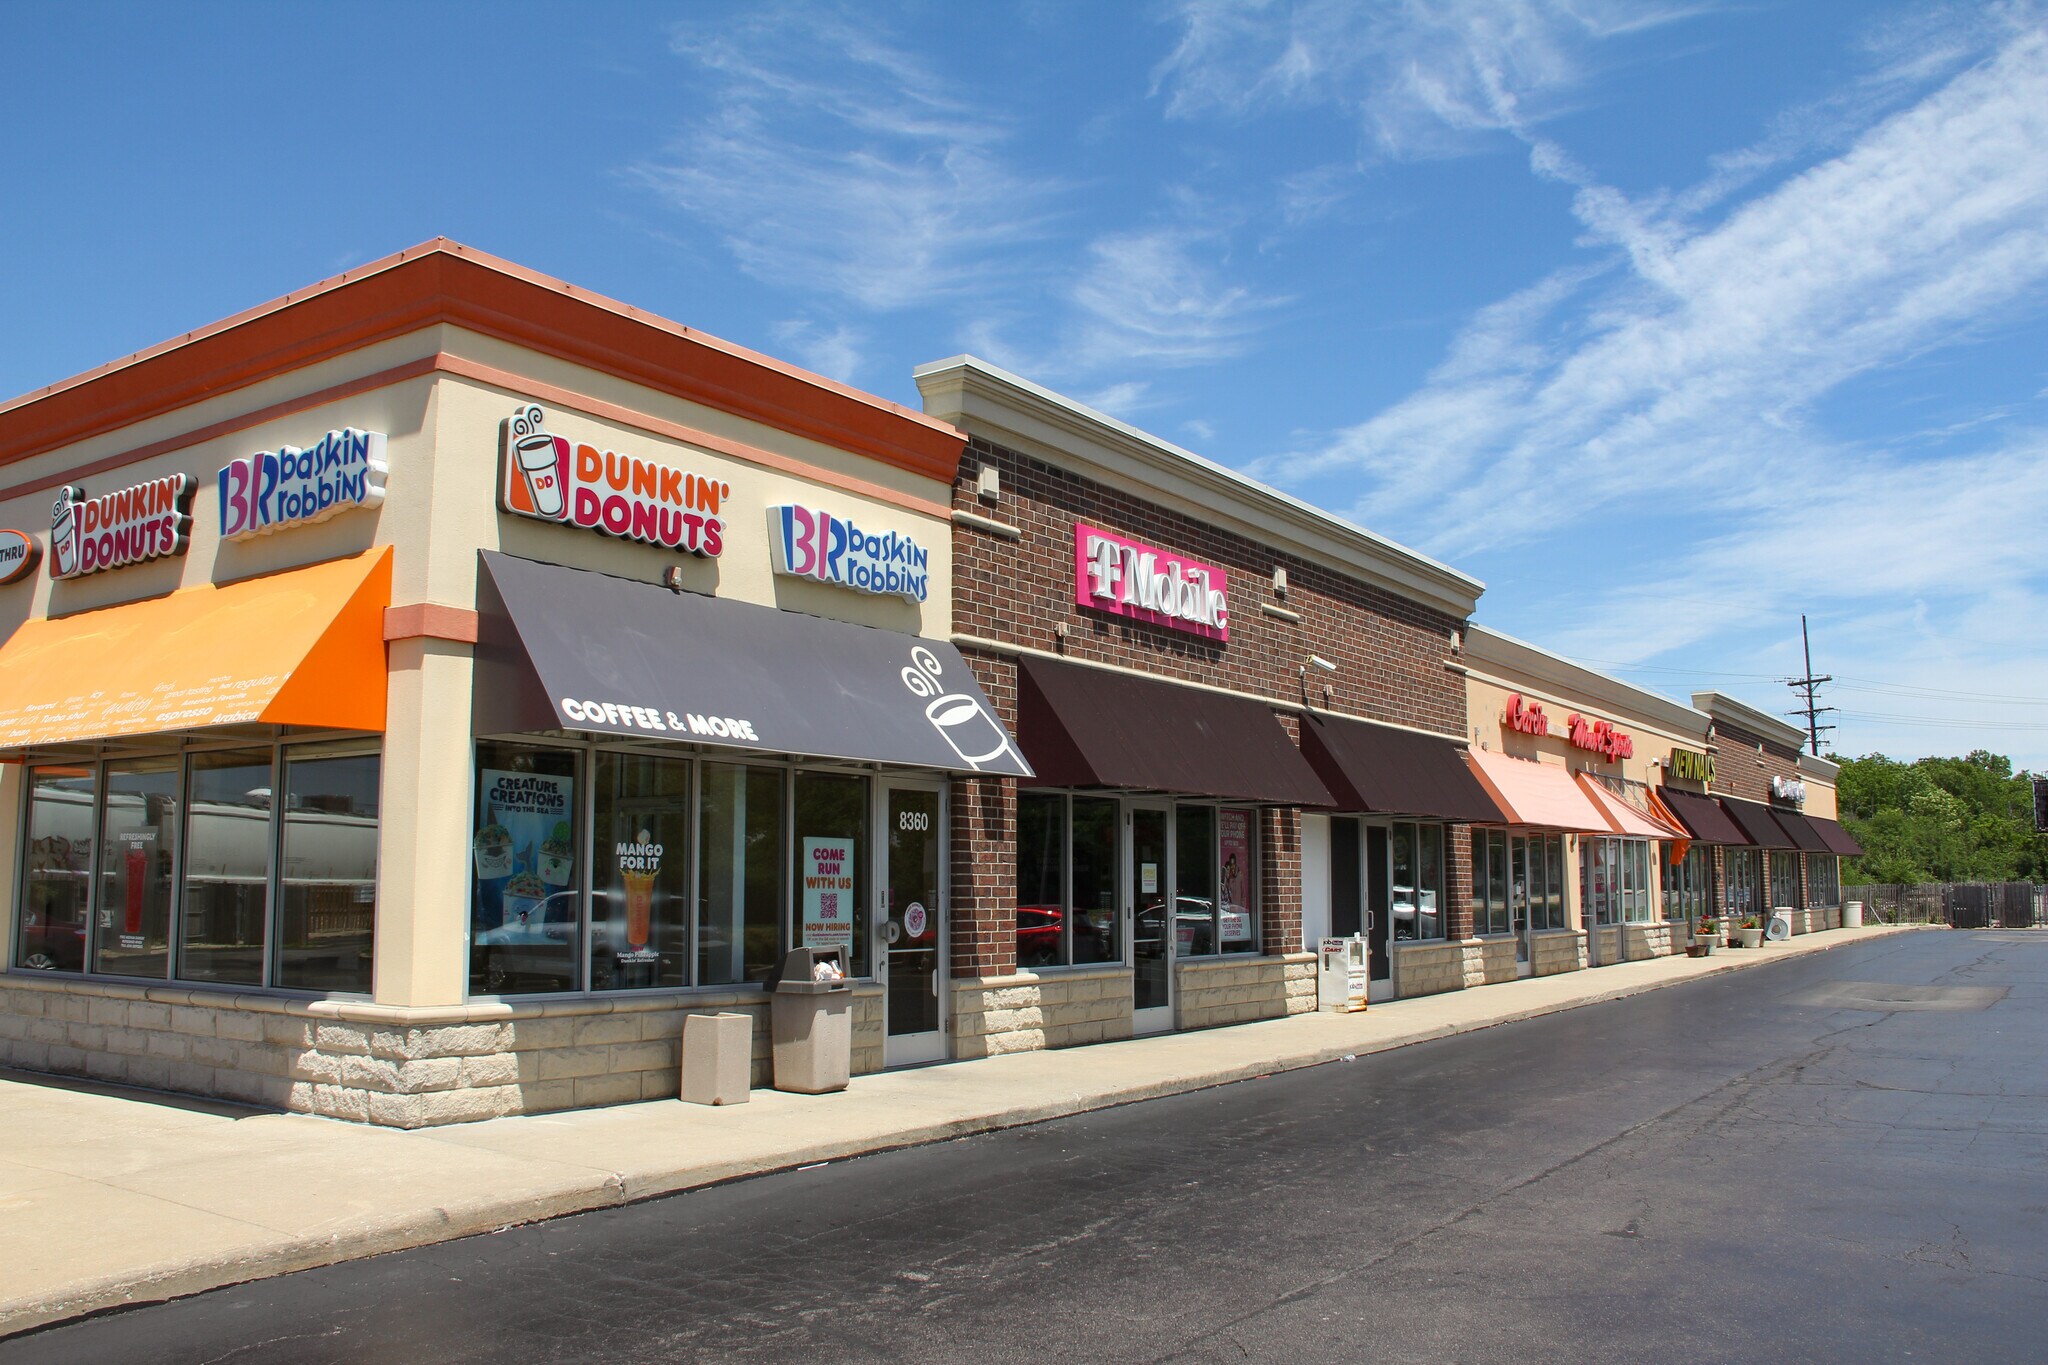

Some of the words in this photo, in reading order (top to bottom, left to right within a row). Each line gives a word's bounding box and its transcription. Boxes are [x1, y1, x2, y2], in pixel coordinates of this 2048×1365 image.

[280, 429, 369, 484] baskin
[535, 475, 553, 490] DD
[577, 444, 730, 516] DUNKIN'
[278, 467, 367, 522] robbins
[84, 474, 181, 534] DUNKIN'
[575, 486, 723, 556] DONUTS
[61, 540, 70, 555] DD
[82, 515, 173, 570] DONUTS
[847, 520, 928, 571] baskin
[848, 558, 927, 601] robbins
[233, 675, 278, 690] regular
[156, 706, 213, 722] espresso
[210, 711, 259, 724] Arabica
[561, 698, 667, 731] COFFEE
[666, 711, 687, 732] &
[687, 713, 759, 742] MORE
[1672, 749, 1694, 779] NEW
[1694, 753, 1715, 783] NAILS
[497, 777, 558, 794] CREATURE
[490, 788, 564, 807] CREATIONS
[505, 805, 522, 813] INTO
[536, 807, 549, 815] SEA
[900, 811, 928, 831] 8360
[616, 842, 664, 857] MANGO
[813, 848, 845, 861] COME
[620, 856, 645, 869] FOR
[647, 857, 660, 869] IT
[818, 863, 840, 875] RUN
[806, 877, 835, 889] WITH
[838, 877, 852, 890] US
[806, 923, 824, 931] NOW
[826, 923, 850, 931] HIRING
